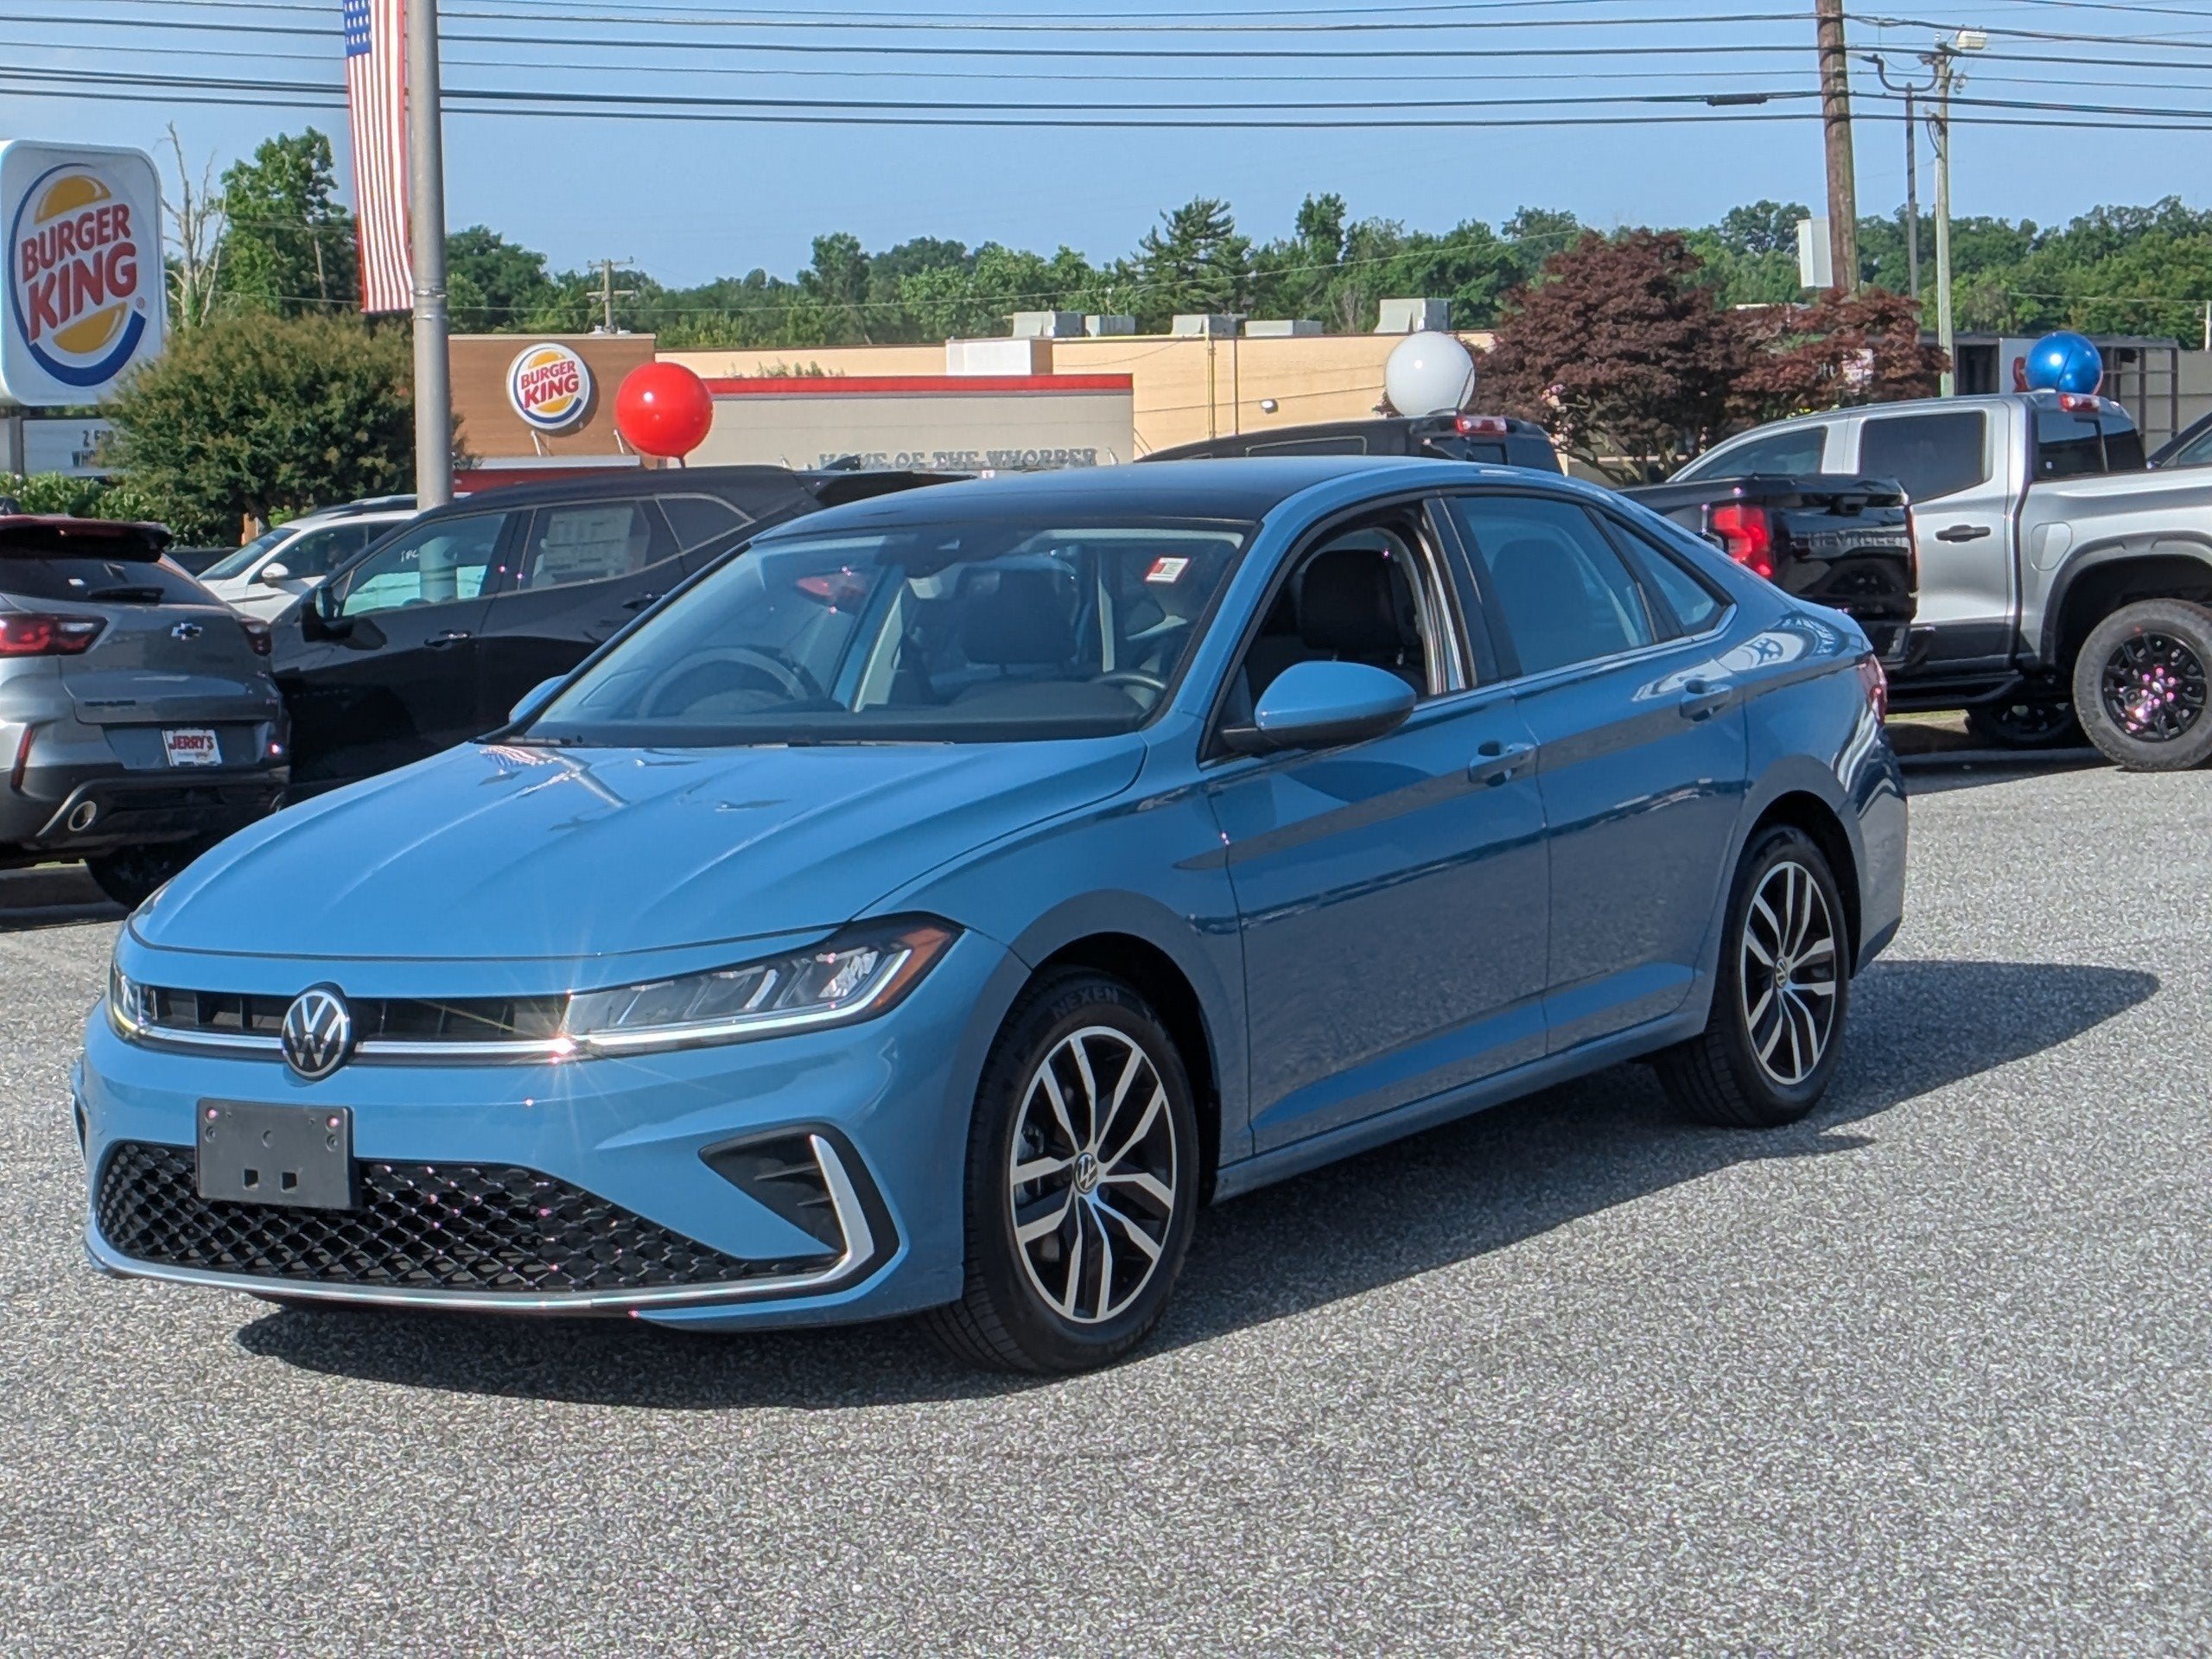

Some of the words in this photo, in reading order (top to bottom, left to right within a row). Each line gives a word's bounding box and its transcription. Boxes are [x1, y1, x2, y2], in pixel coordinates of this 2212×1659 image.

[21, 203, 131, 283] BURGER
[29, 241, 137, 341] KING
[520, 360, 576, 390] BURGER
[524, 373, 579, 409] KING
[819, 452, 887, 470] HME
[895, 451, 925, 469] OF
[932, 449, 979, 469] THE
[986, 448, 1097, 468] WHOPPER
[1052, 985, 1120, 1020] NEXEN
